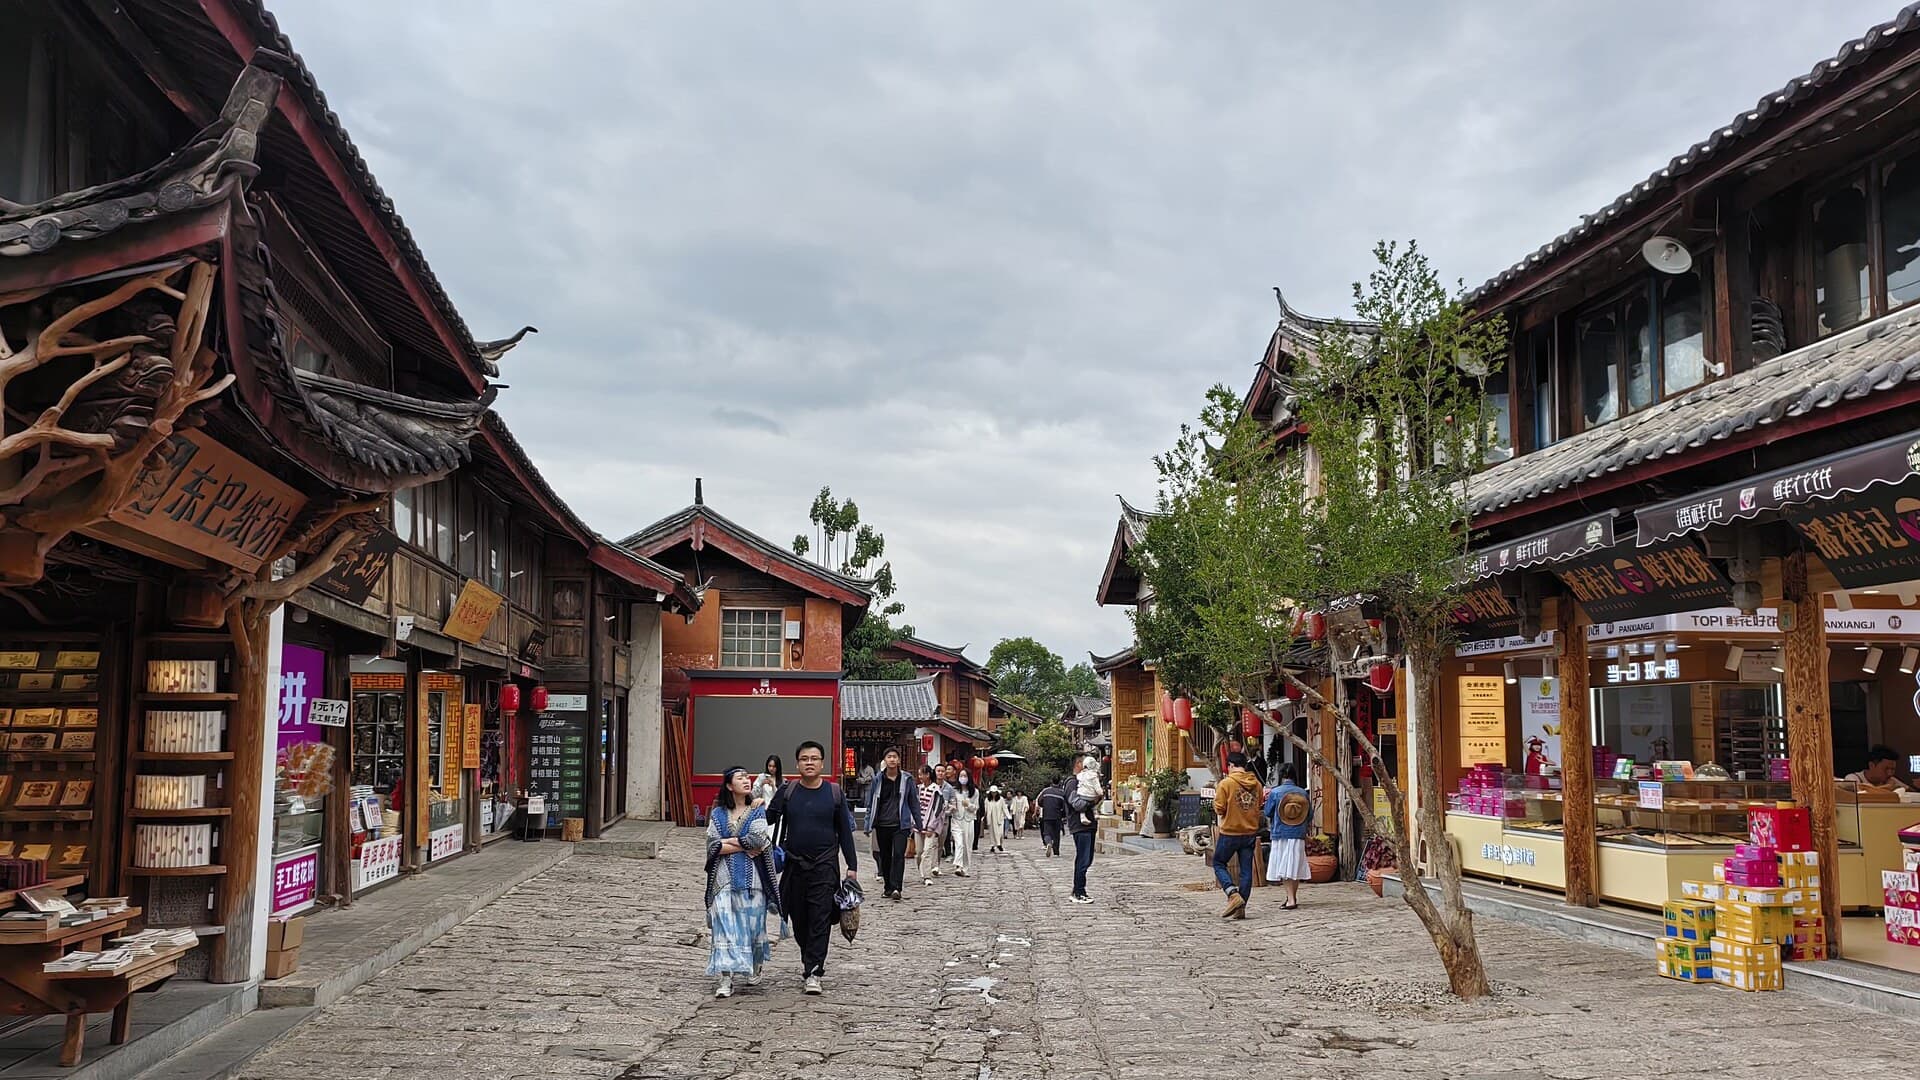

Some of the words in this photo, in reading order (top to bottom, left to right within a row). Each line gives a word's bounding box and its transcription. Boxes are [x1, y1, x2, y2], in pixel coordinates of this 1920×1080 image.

[1773, 466, 1832, 501] 鲜花饼
[1676, 498, 1723, 528] 潘祥记
[1798, 506, 1909, 560] 潘祥记
[1516, 537, 1549, 561] 鲜花饼
[1636, 546, 1717, 588] 鲜花饼
[1559, 564, 1628, 601] 潘祥记
[1618, 622, 1655, 633] PANXIANGJI
[1824, 620, 1876, 630] ANXIANGJI
[312, 701, 346, 714] 1元1个
[531, 735, 560, 744] 玉龙雪山
[275, 859, 315, 892] 手工鲜花饼
